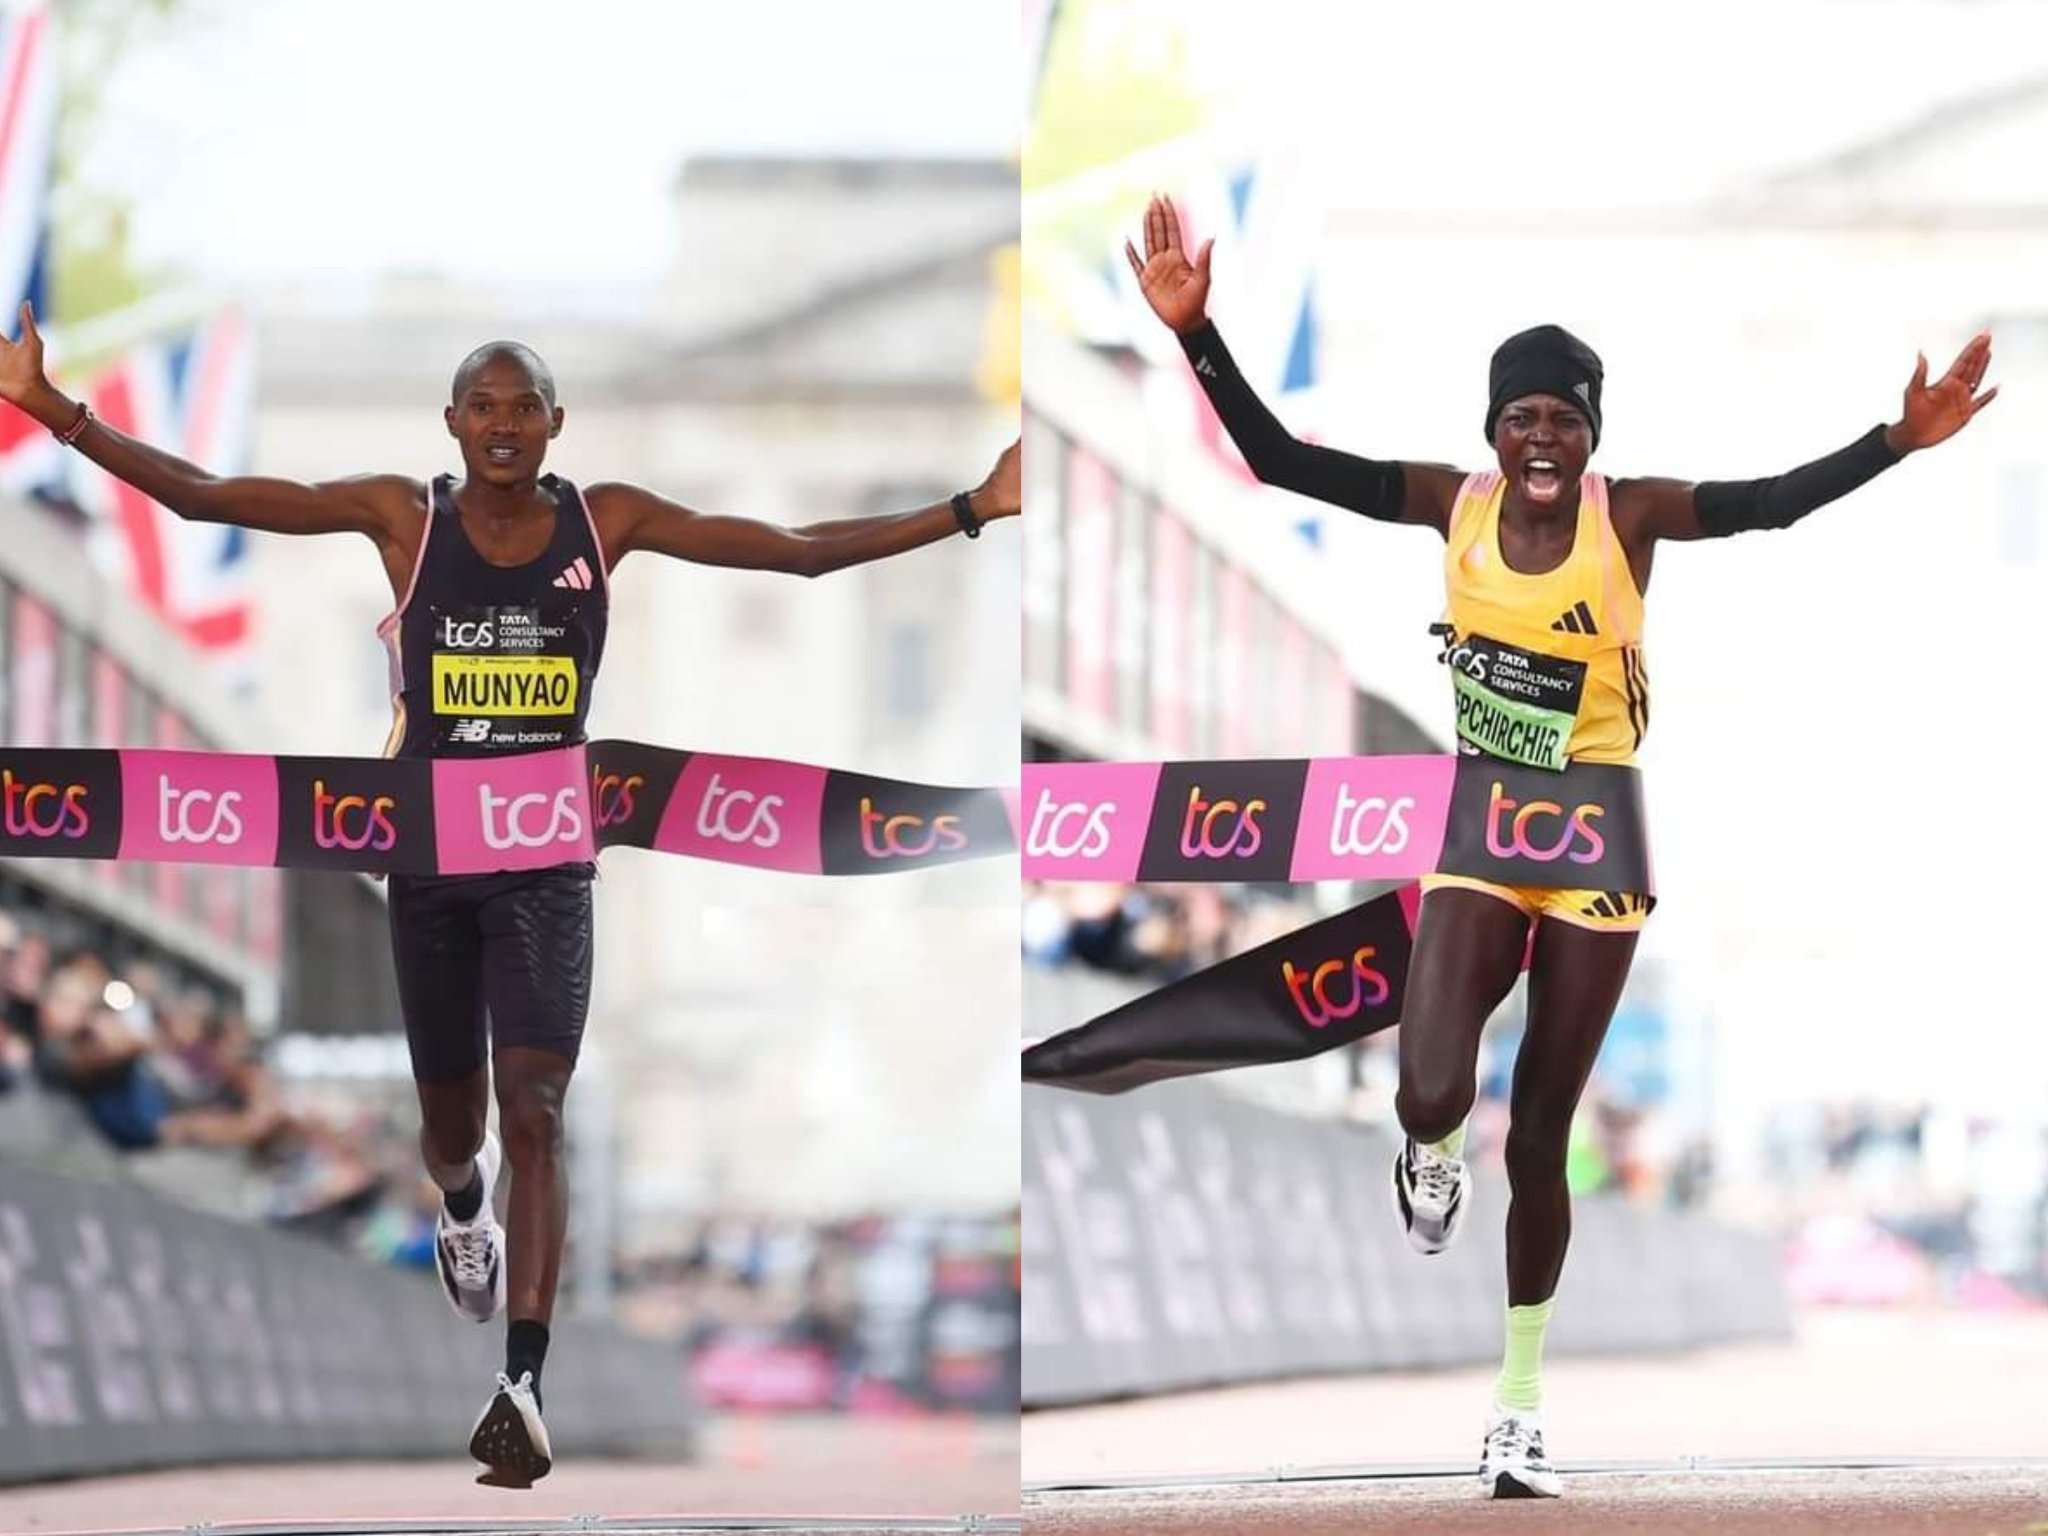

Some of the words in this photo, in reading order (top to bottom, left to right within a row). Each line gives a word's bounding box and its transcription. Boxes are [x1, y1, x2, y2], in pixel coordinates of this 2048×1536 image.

[445, 616, 494, 647] tcs
[499, 615, 530, 625] TATA
[499, 627, 566, 638] CONSULTANCY
[499, 638, 545, 648] SERVICES
[443, 672, 570, 707] MUNYAO
[1489, 675, 1541, 698] SERVICES
[1492, 663, 1574, 693] CONSULTANCY
[1496, 651, 1530, 669] TATA
[491, 732, 517, 743] new
[518, 731, 562, 743] balance
[2, 769, 89, 839] tcs
[158, 773, 243, 845] tcs
[314, 780, 397, 851] tcs
[479, 784, 584, 849] tcs
[696, 773, 782, 849] tcs
[859, 797, 968, 858] tcs
[1026, 788, 1117, 859] tcs
[1179, 787, 1267, 859] tcs
[1329, 782, 1414, 857] tcs
[1484, 781, 1606, 864] tcs
[1281, 945, 1391, 1029] tcs
